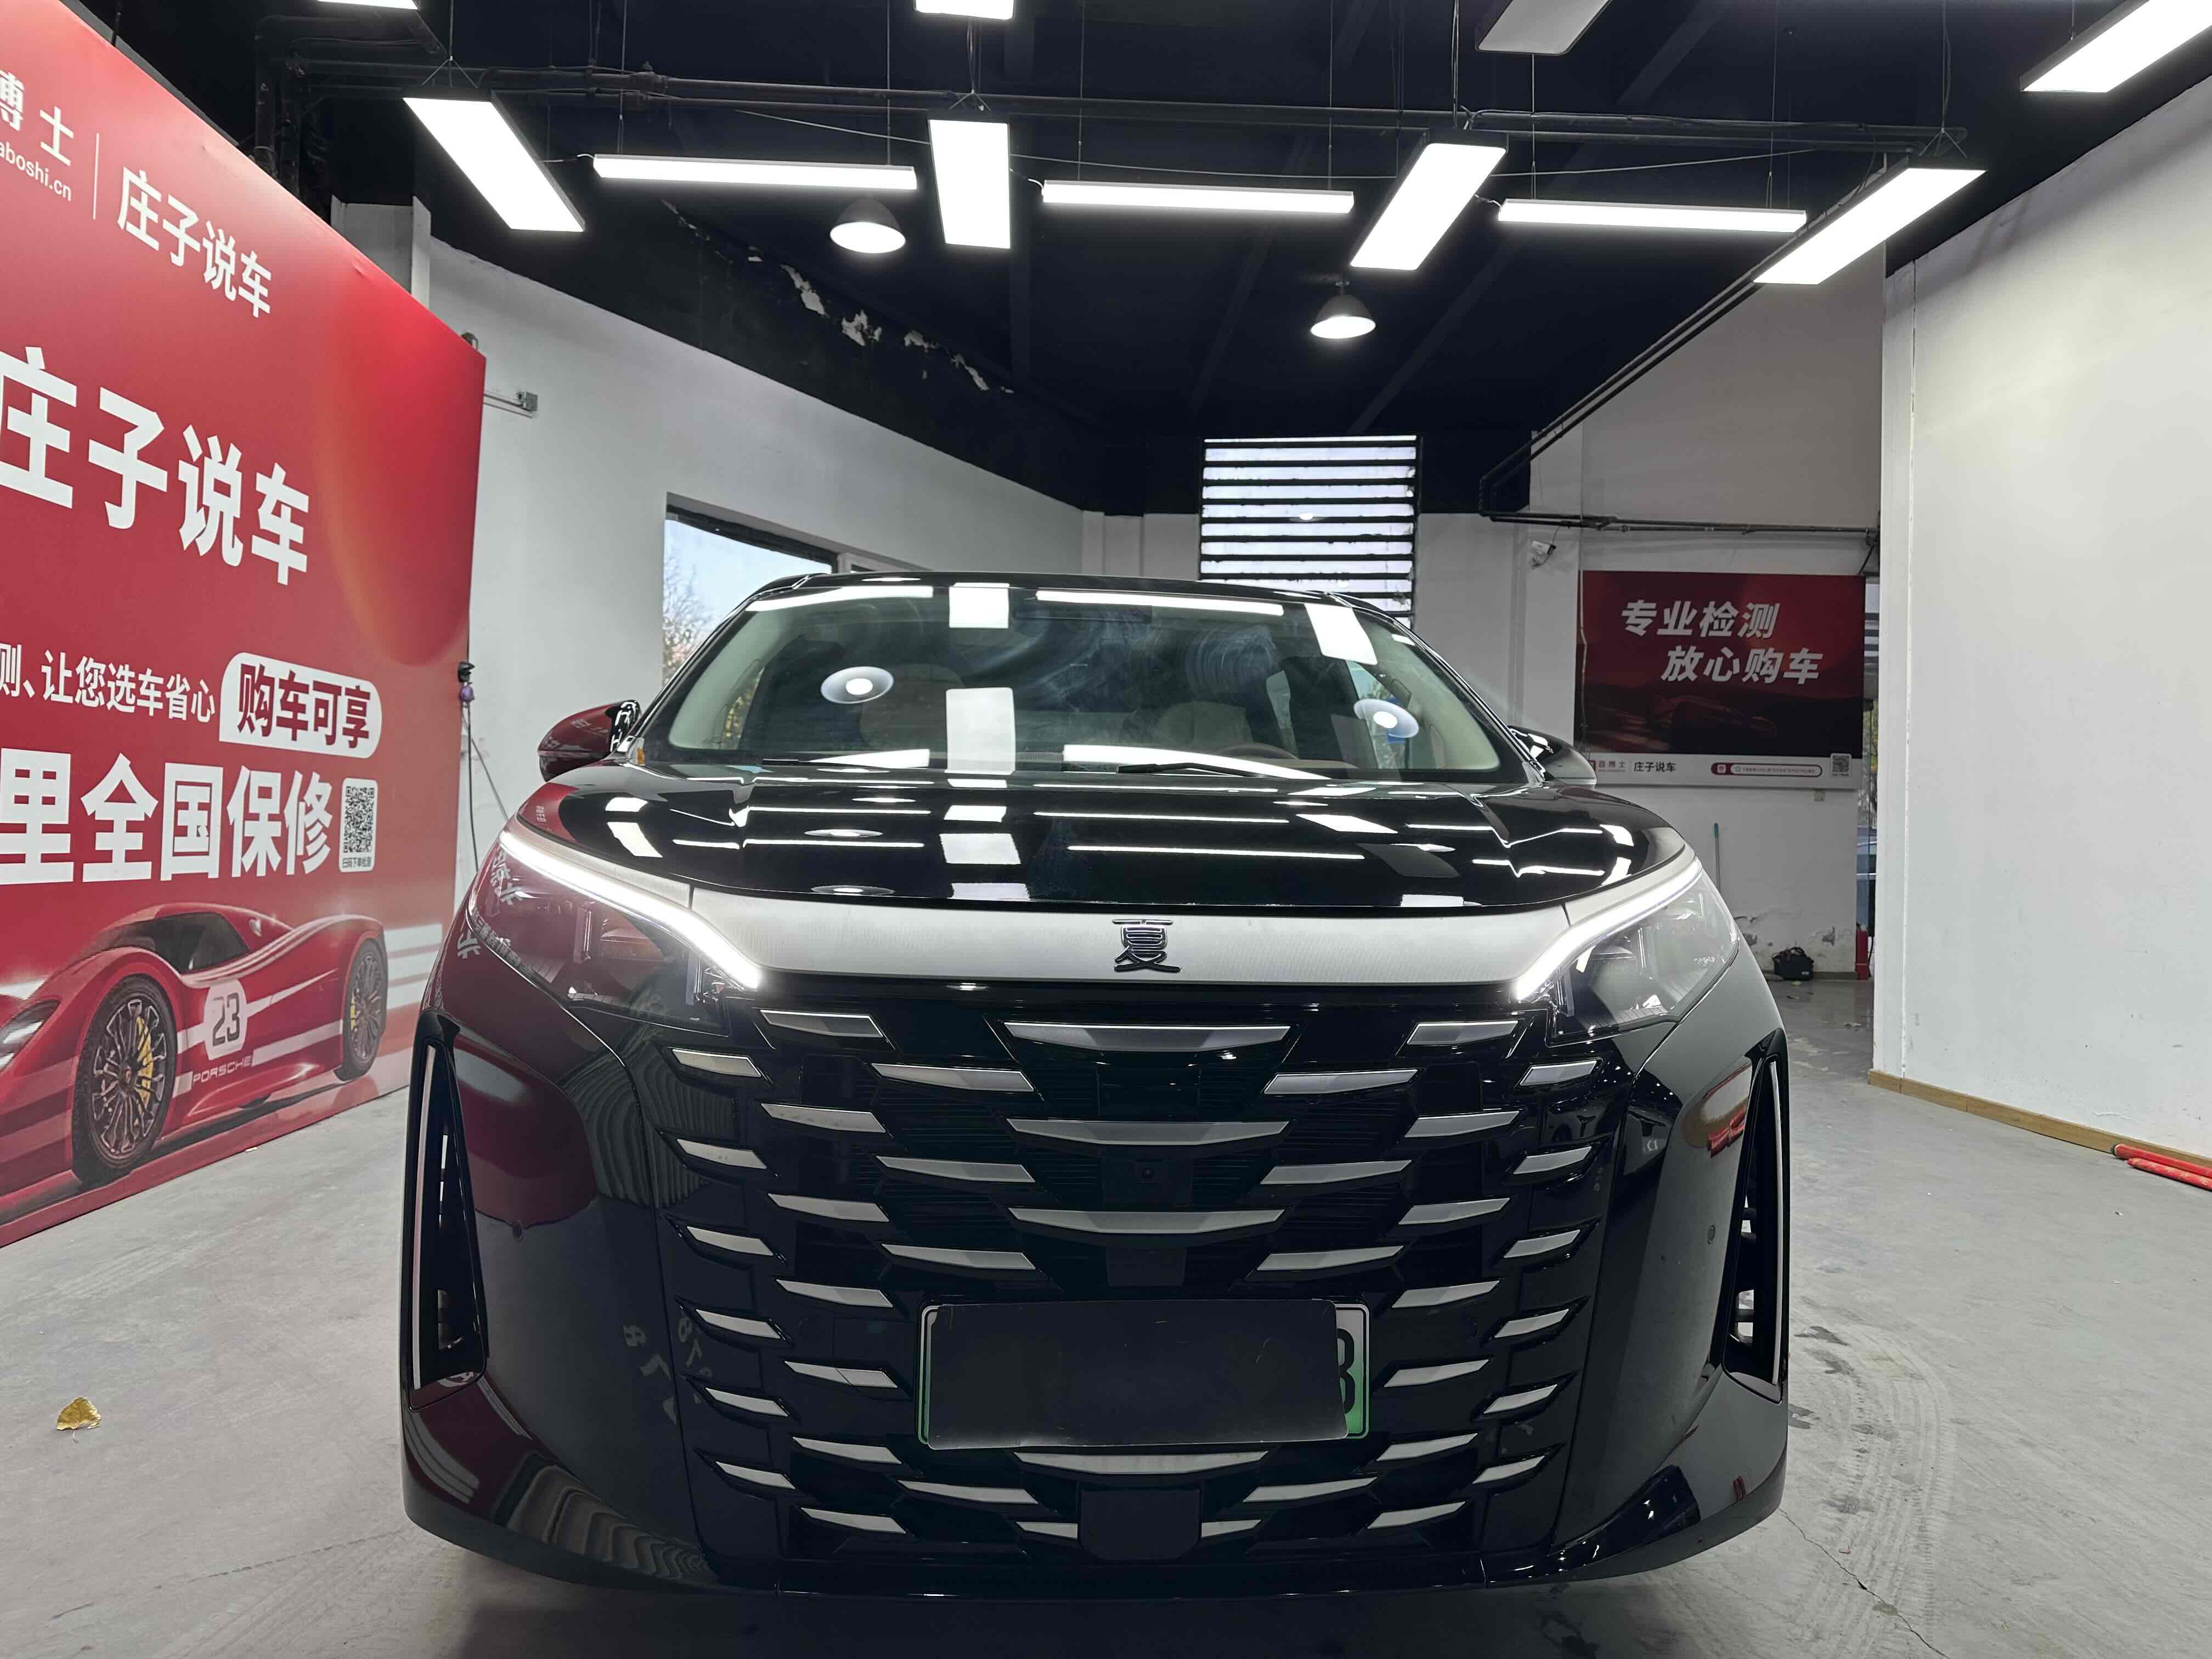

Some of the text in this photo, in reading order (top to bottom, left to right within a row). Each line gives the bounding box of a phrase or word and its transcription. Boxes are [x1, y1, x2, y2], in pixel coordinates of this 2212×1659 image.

[117, 166, 272, 318] 庄子说车
[0, 346, 309, 585] 庄子说车
[1622, 600, 1780, 638] 专业检测
[1661, 645, 1823, 685] 放心购车
[237, 663, 371, 749] 购车可享
[1633, 761, 1677, 773] 庄子说车
[0, 747, 333, 885] 里全国保修
[213, 992, 240, 1046] 23
[193, 1055, 252, 1085] PORSCHE
